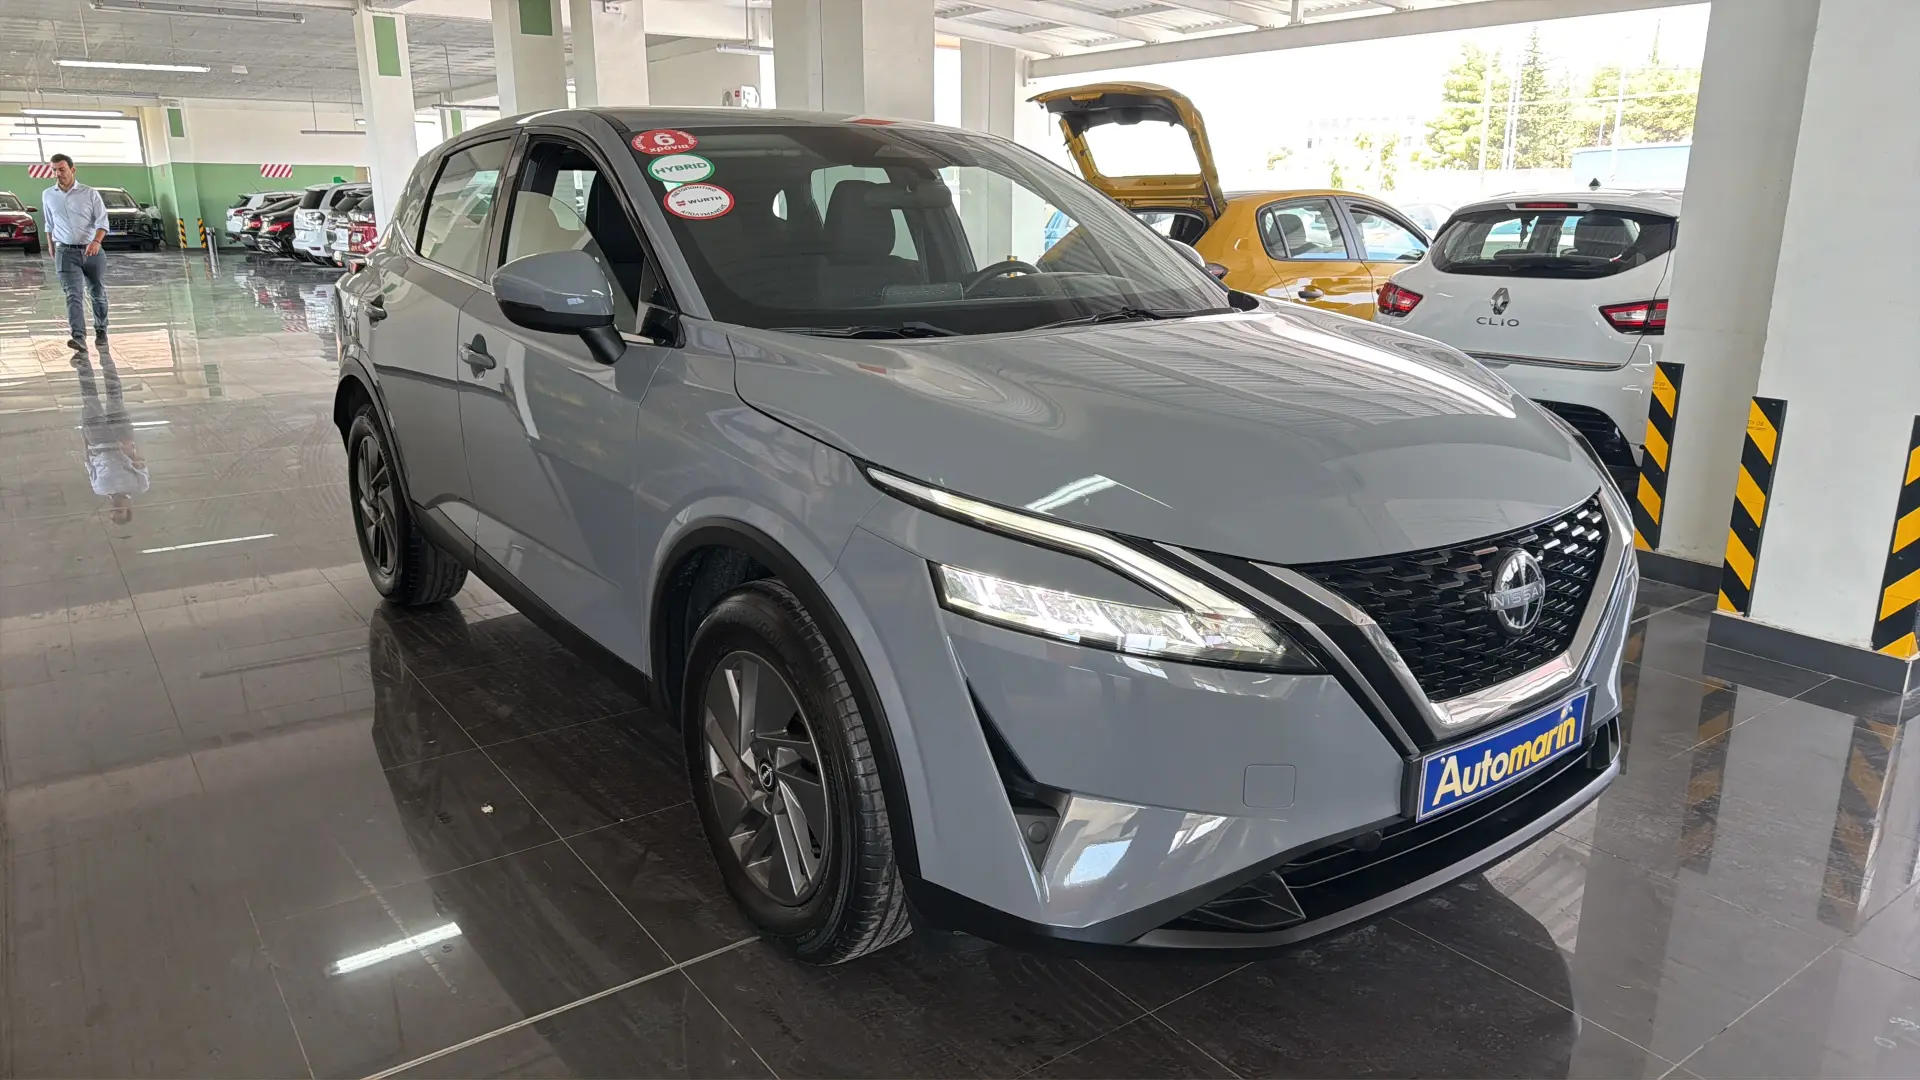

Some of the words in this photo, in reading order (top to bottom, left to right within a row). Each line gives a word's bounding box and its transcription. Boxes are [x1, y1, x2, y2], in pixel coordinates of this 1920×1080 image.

[654, 134, 675, 146] 6
[649, 144, 689, 153] χρόνια
[654, 162, 708, 174] HYBRID
[1476, 316, 1519, 327] CLIO
[1492, 584, 1545, 608] NISSAN
[1432, 708, 1576, 807] Automarin
